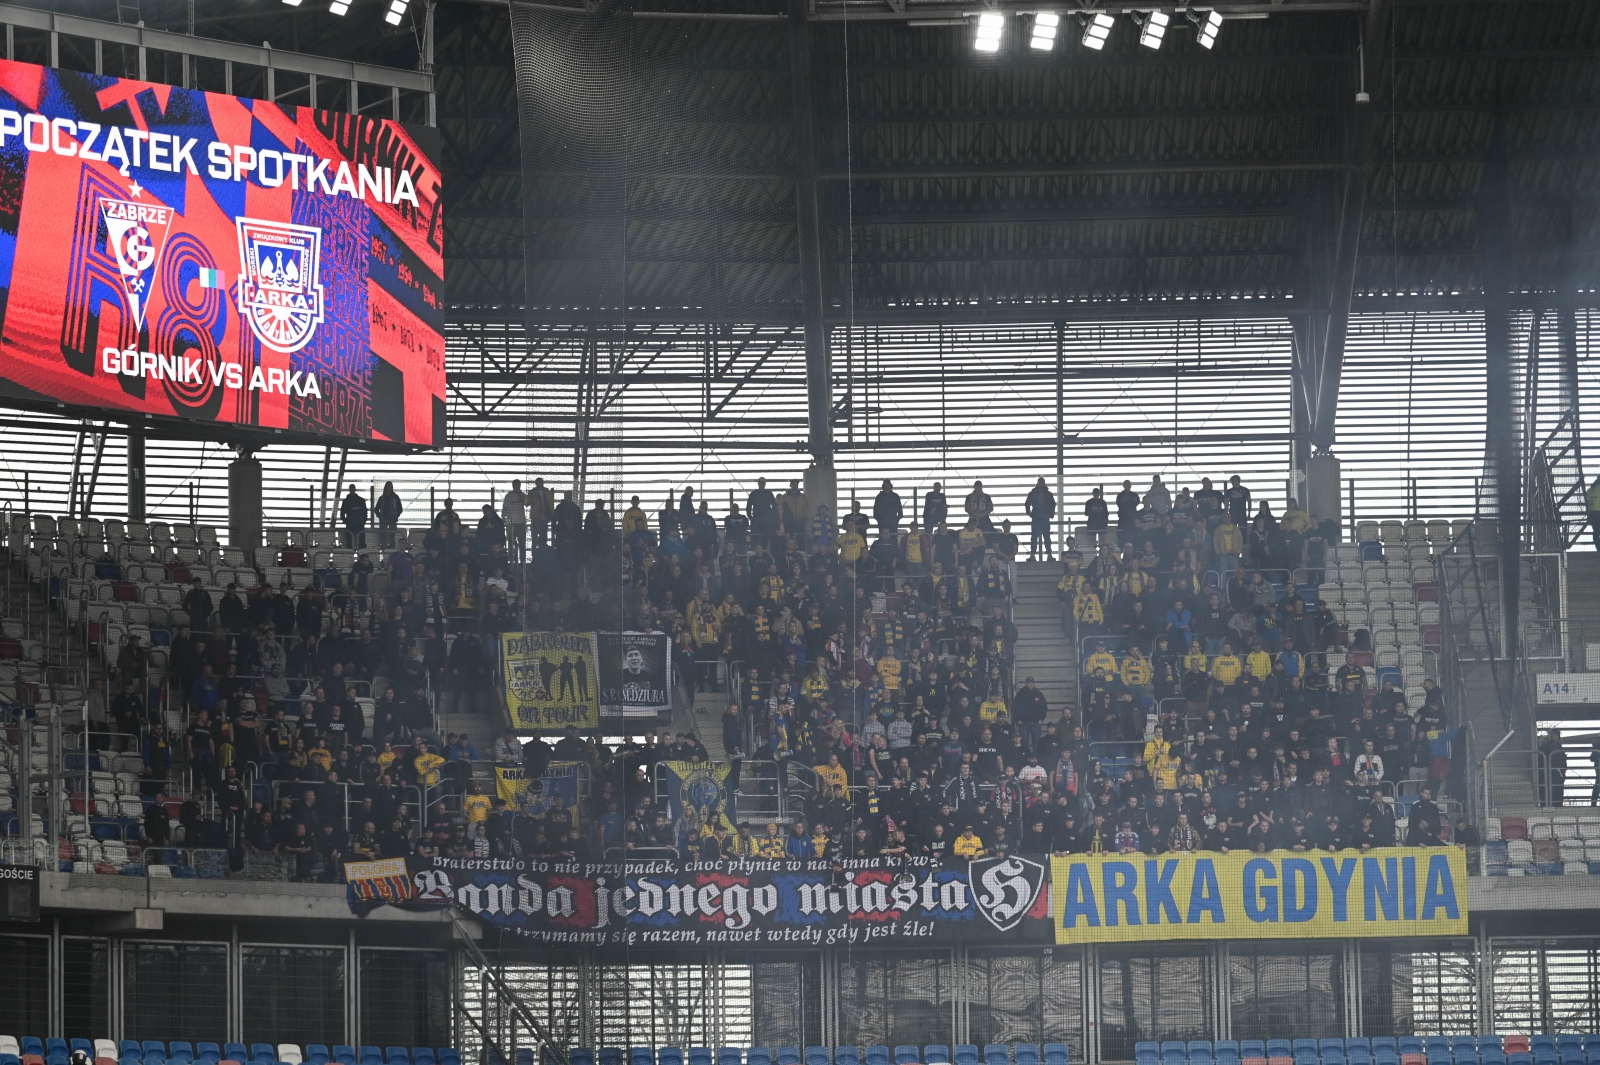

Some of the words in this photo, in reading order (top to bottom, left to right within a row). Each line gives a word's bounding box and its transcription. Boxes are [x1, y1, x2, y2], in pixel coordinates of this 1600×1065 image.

[0, 109, 199, 177] POCZĄTEK
[208, 142, 420, 208] SPOTKANIA
[107, 201, 167, 225] ZABRZE
[252, 232, 288, 243] ZWIĄZKOWY
[289, 237, 305, 246] KLUB
[249, 247, 257, 276] MORSKI
[255, 289, 309, 310] ARKA
[102, 344, 203, 385] GÓRNIK
[207, 359, 243, 390] VS
[248, 370, 322, 399] ARKA
[1543, 683, 1570, 695] A14
[543, 704, 589, 723] TOUR
[351, 863, 402, 876] POLONIA
[433, 856, 525, 871] Braterstwo
[532, 859, 549, 873] to
[555, 857, 580, 873] nie
[586, 856, 679, 878] przypadek,
[685, 857, 723, 872] choć
[728, 857, 781, 875] płynie
[787, 857, 803, 871] w
[843, 856, 880, 869] inna
[413, 868, 576, 917] Banda
[592, 875, 778, 929] jednego
[798, 871, 970, 917] miasta
[1062, 858, 1226, 929] ARKA
[1242, 855, 1461, 924] GDYNIA
[612, 927, 637, 945] się
[642, 930, 702, 944] razem,
[706, 929, 761, 942] nawet
[767, 928, 822, 945] wtedy
[827, 926, 858, 945] gdy
[862, 923, 896, 941] jest
[903, 921, 935, 938] źle!
